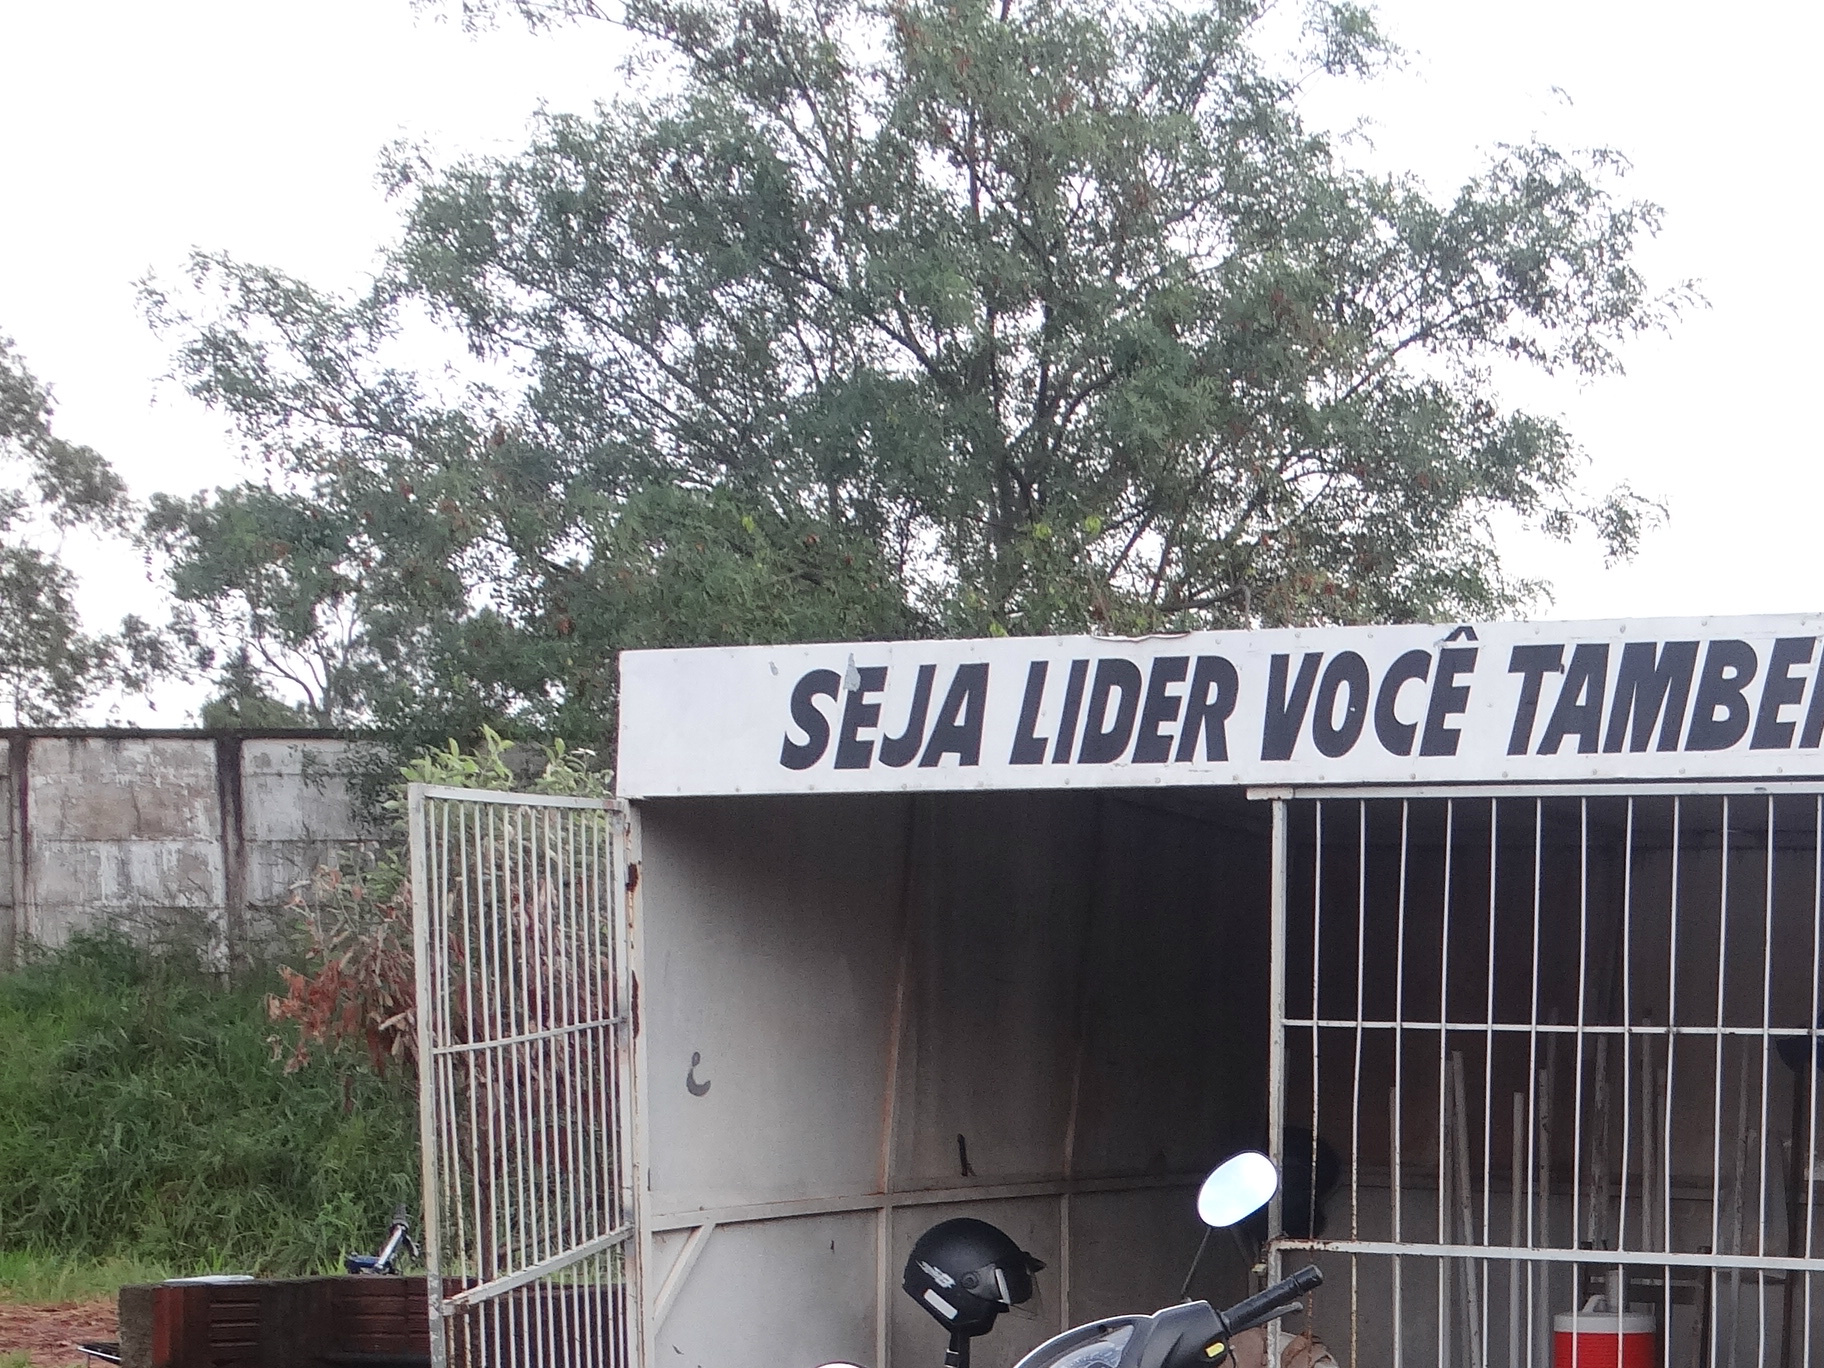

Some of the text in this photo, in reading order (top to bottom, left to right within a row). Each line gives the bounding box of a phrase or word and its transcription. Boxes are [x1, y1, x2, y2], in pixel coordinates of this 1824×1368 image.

[780, 661, 991, 770] SEJA
[1008, 655, 1240, 766] LIDER
[1260, 626, 1479, 761] VOCÊ
